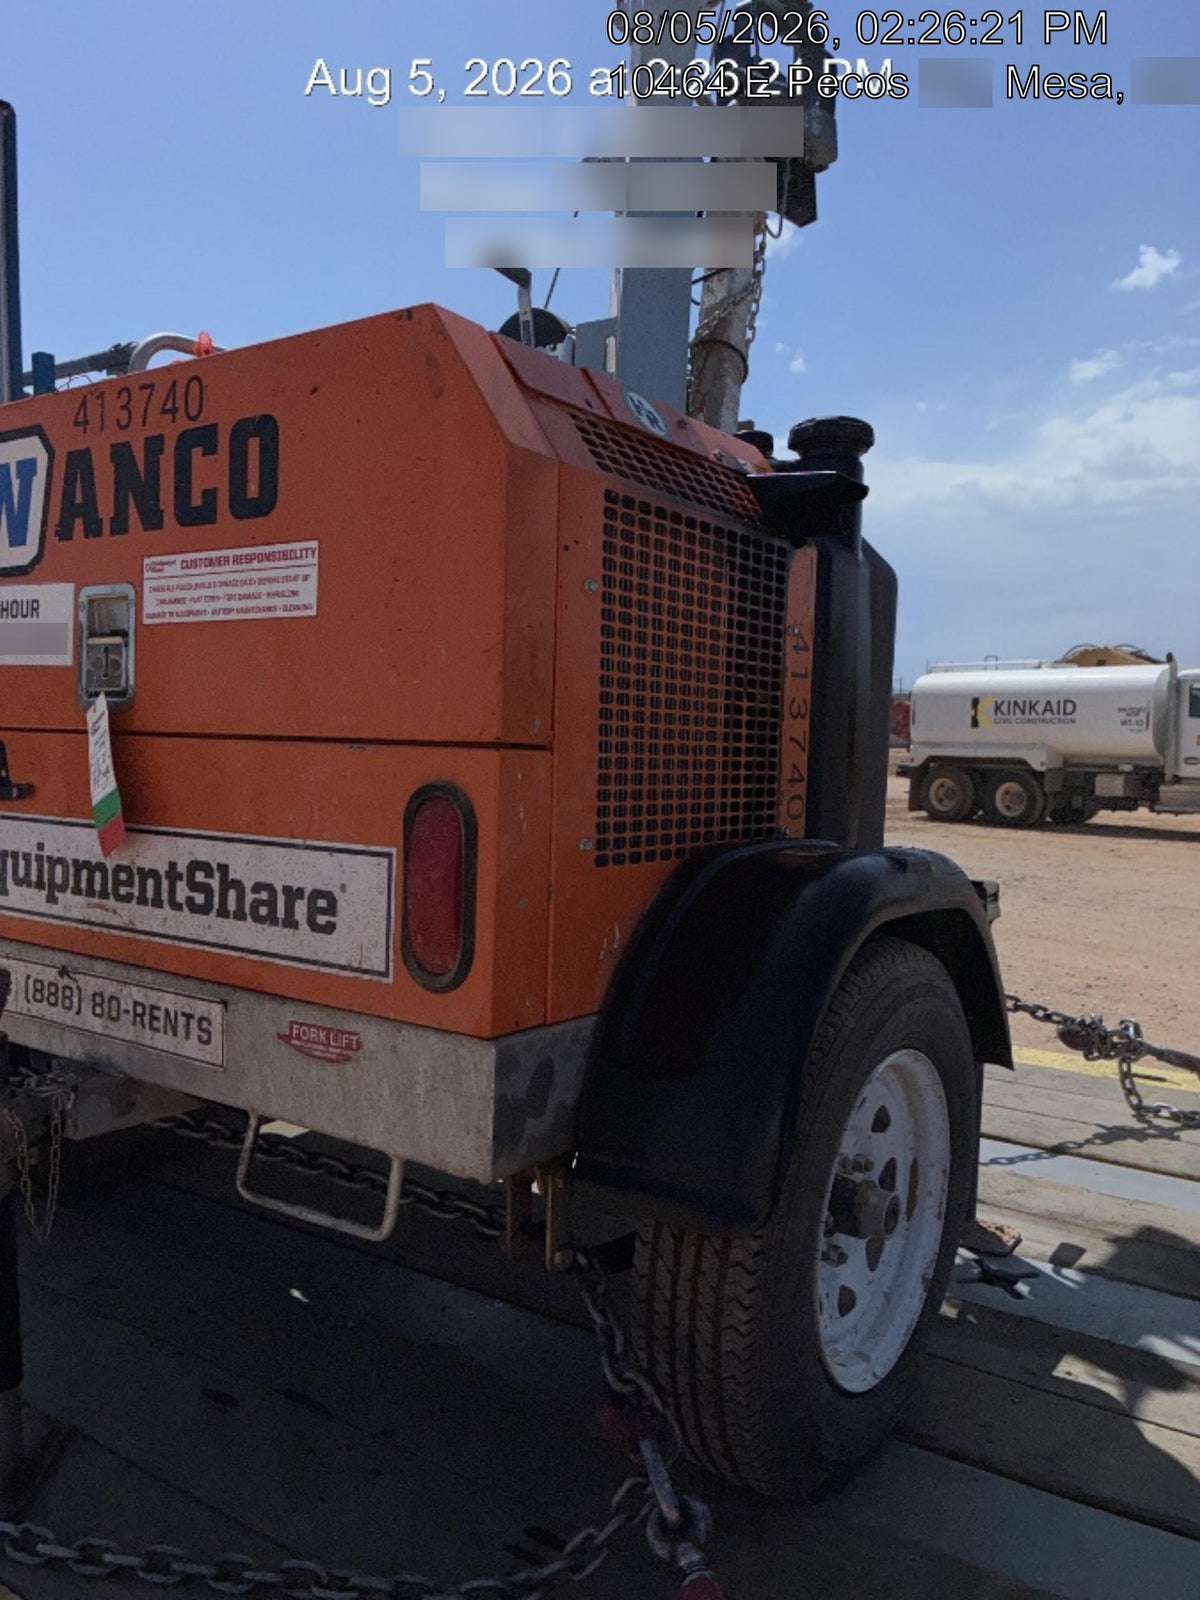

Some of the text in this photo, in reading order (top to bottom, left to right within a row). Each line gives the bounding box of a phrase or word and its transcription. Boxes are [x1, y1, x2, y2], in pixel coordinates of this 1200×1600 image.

[73, 375, 204, 434] 413740
[181, 553, 231, 570] CUSTOMER
[232, 547, 317, 567] RESPONSIBILITY
[786, 628, 810, 821] 413740
[994, 699, 1077, 716] KINKAID
[25, 974, 213, 1045] (888) 80-RENTS
